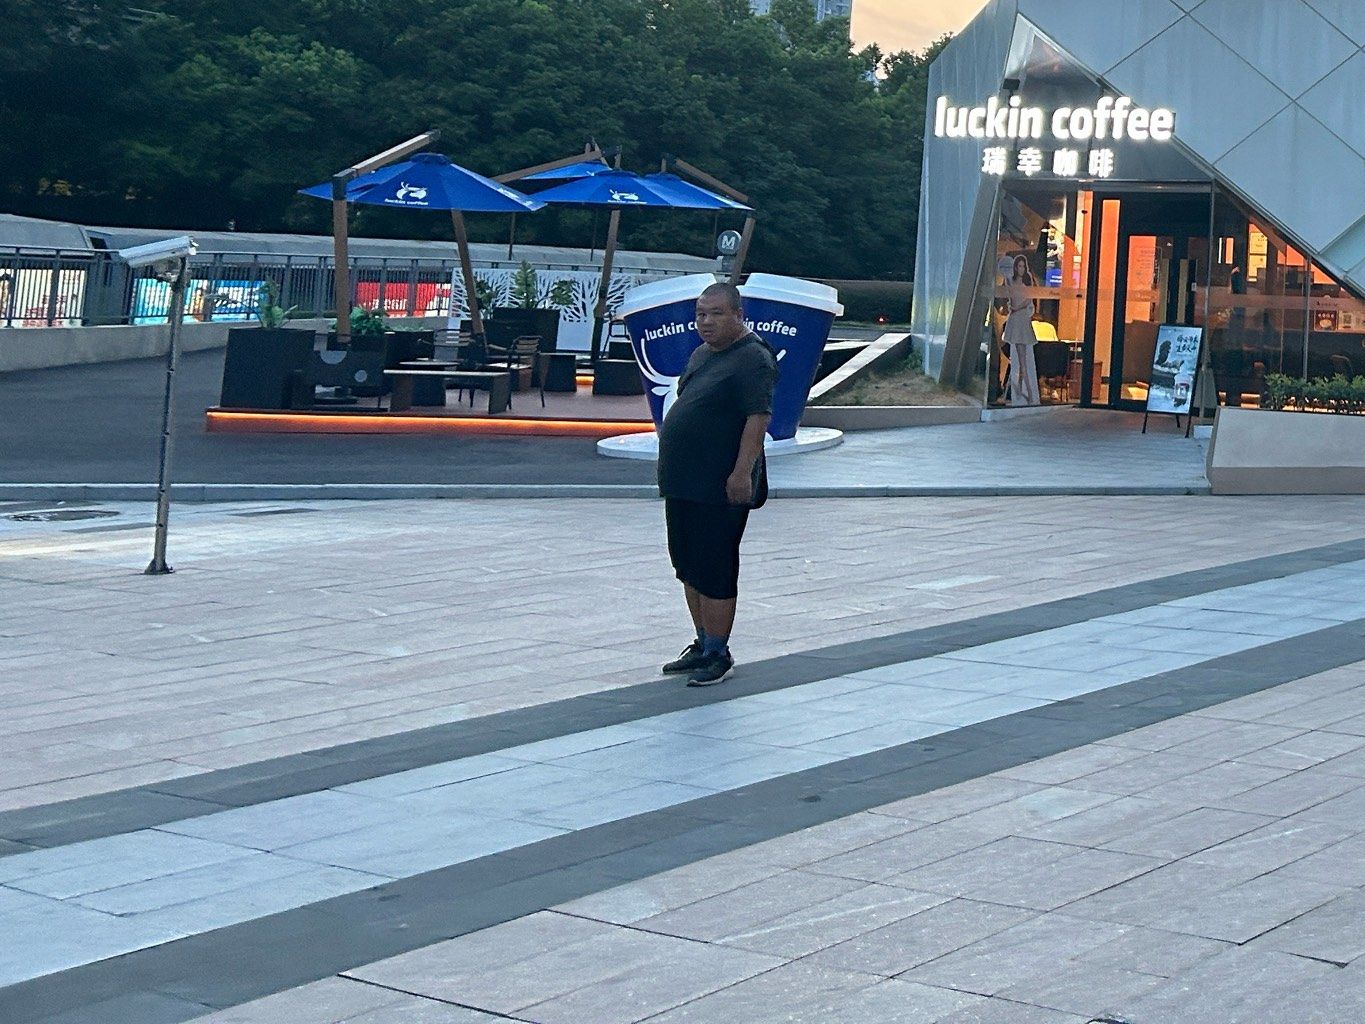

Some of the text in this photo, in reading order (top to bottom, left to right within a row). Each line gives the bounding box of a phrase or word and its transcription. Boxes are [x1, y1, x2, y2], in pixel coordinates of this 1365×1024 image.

[934, 95, 1175, 141] luckin coffee
[981, 146, 1114, 178] 瑞幸咖啡
[644, 321, 685, 342] luckin
[756, 319, 798, 337] coffee
